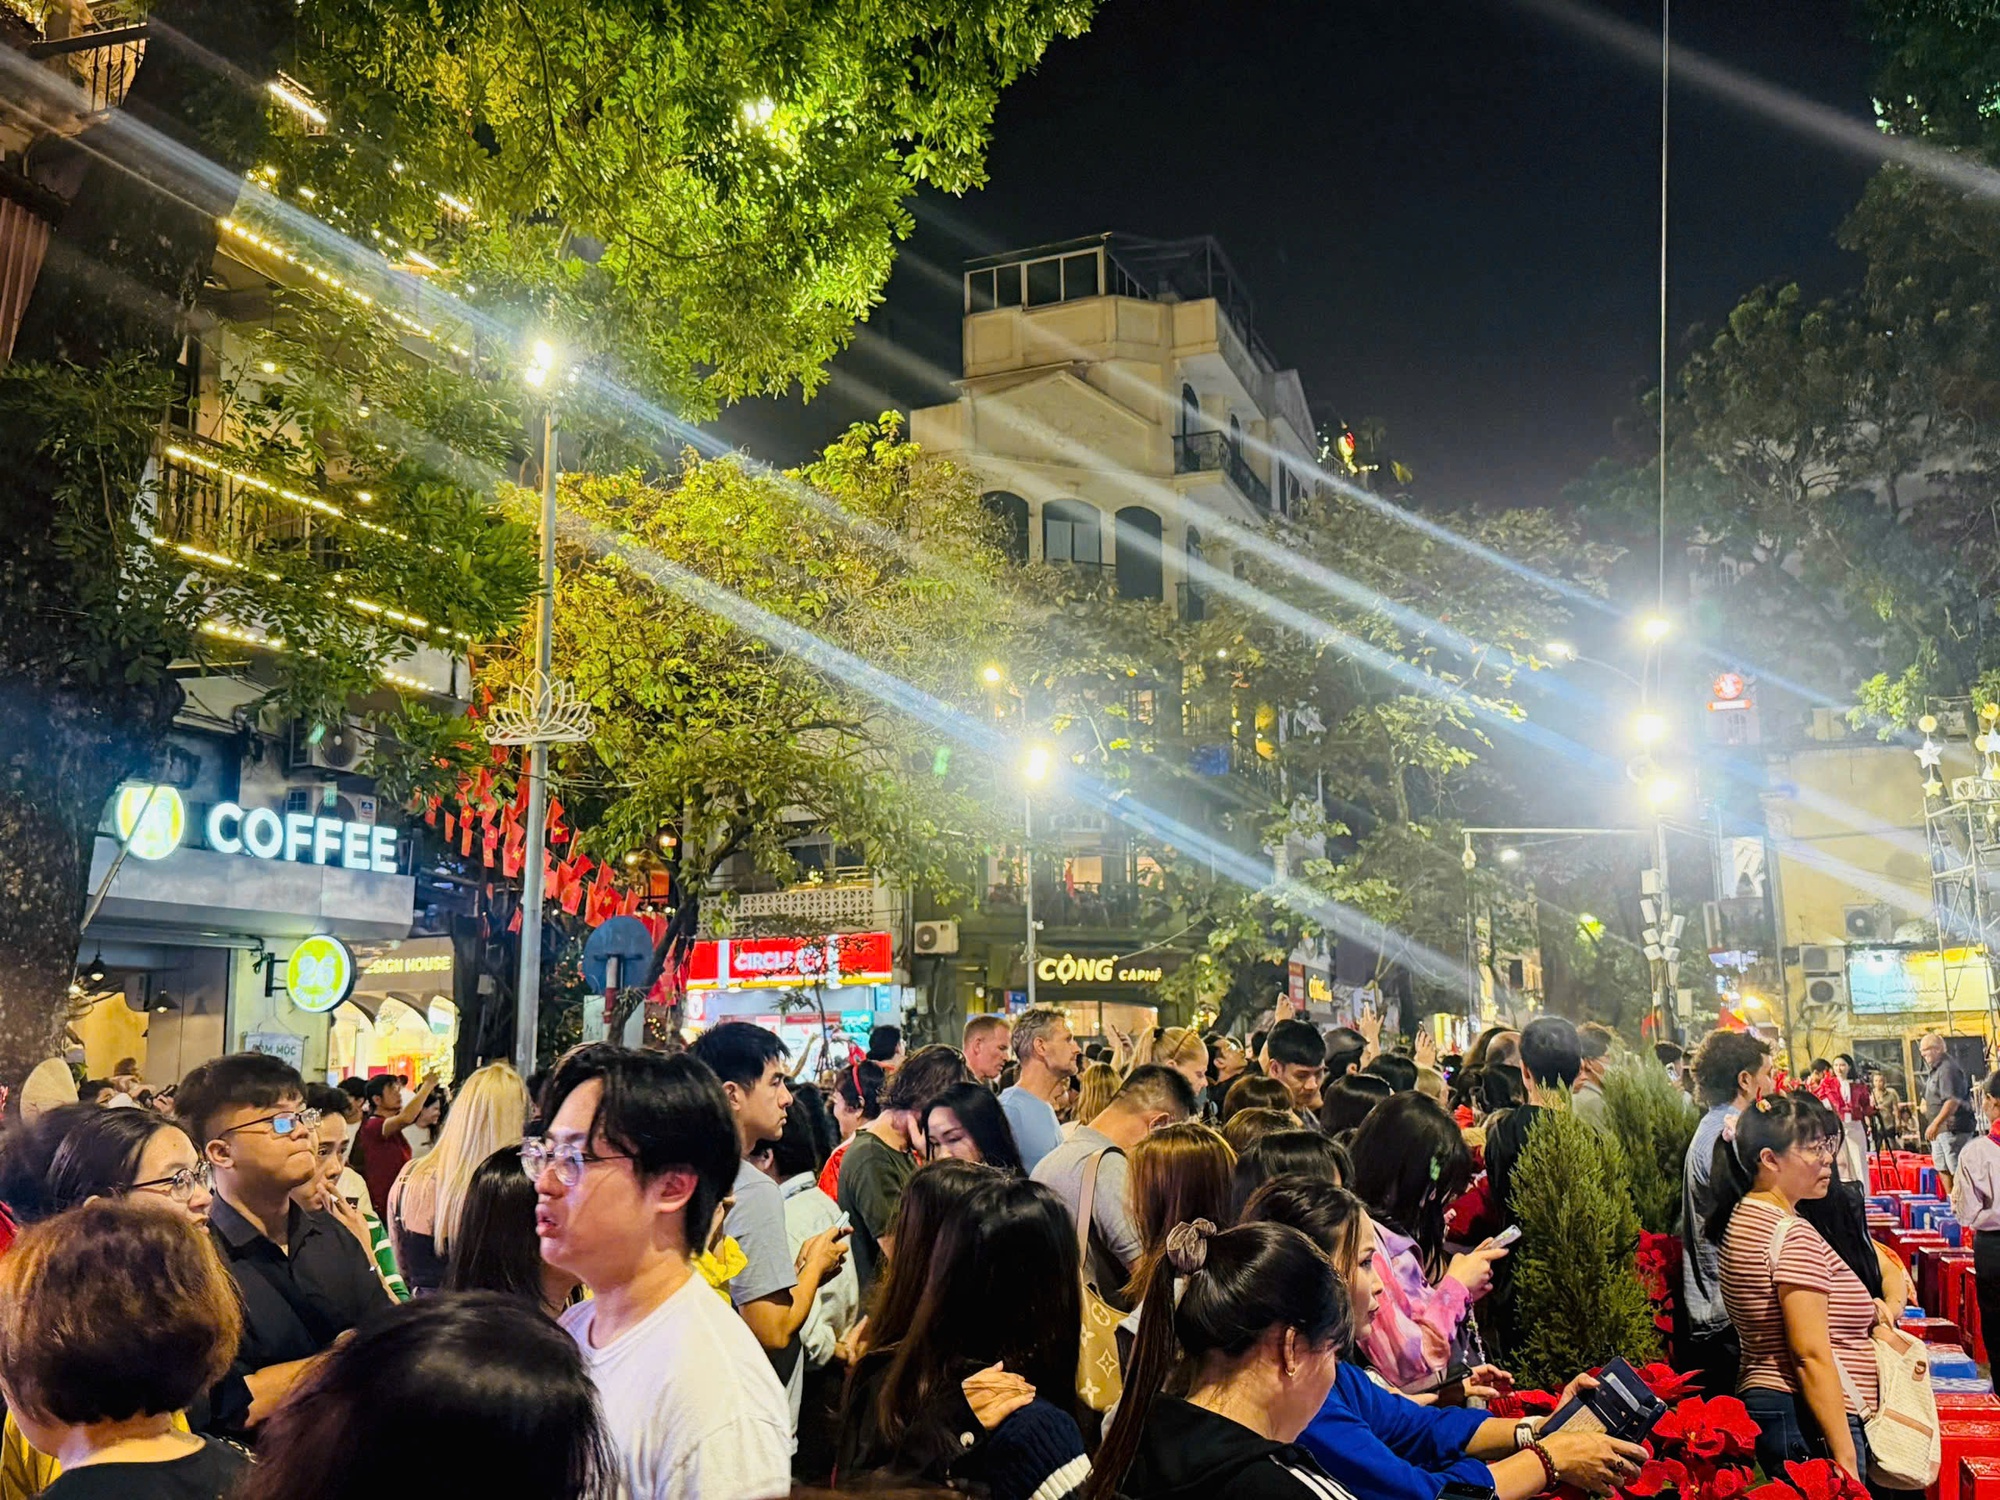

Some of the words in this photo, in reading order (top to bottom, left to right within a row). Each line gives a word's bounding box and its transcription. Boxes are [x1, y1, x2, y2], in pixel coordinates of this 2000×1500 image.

[206, 802, 398, 874] COFFEE
[298, 955, 335, 987] 26
[404, 956, 451, 972] HOUSE
[734, 951, 795, 970] CIRCLE
